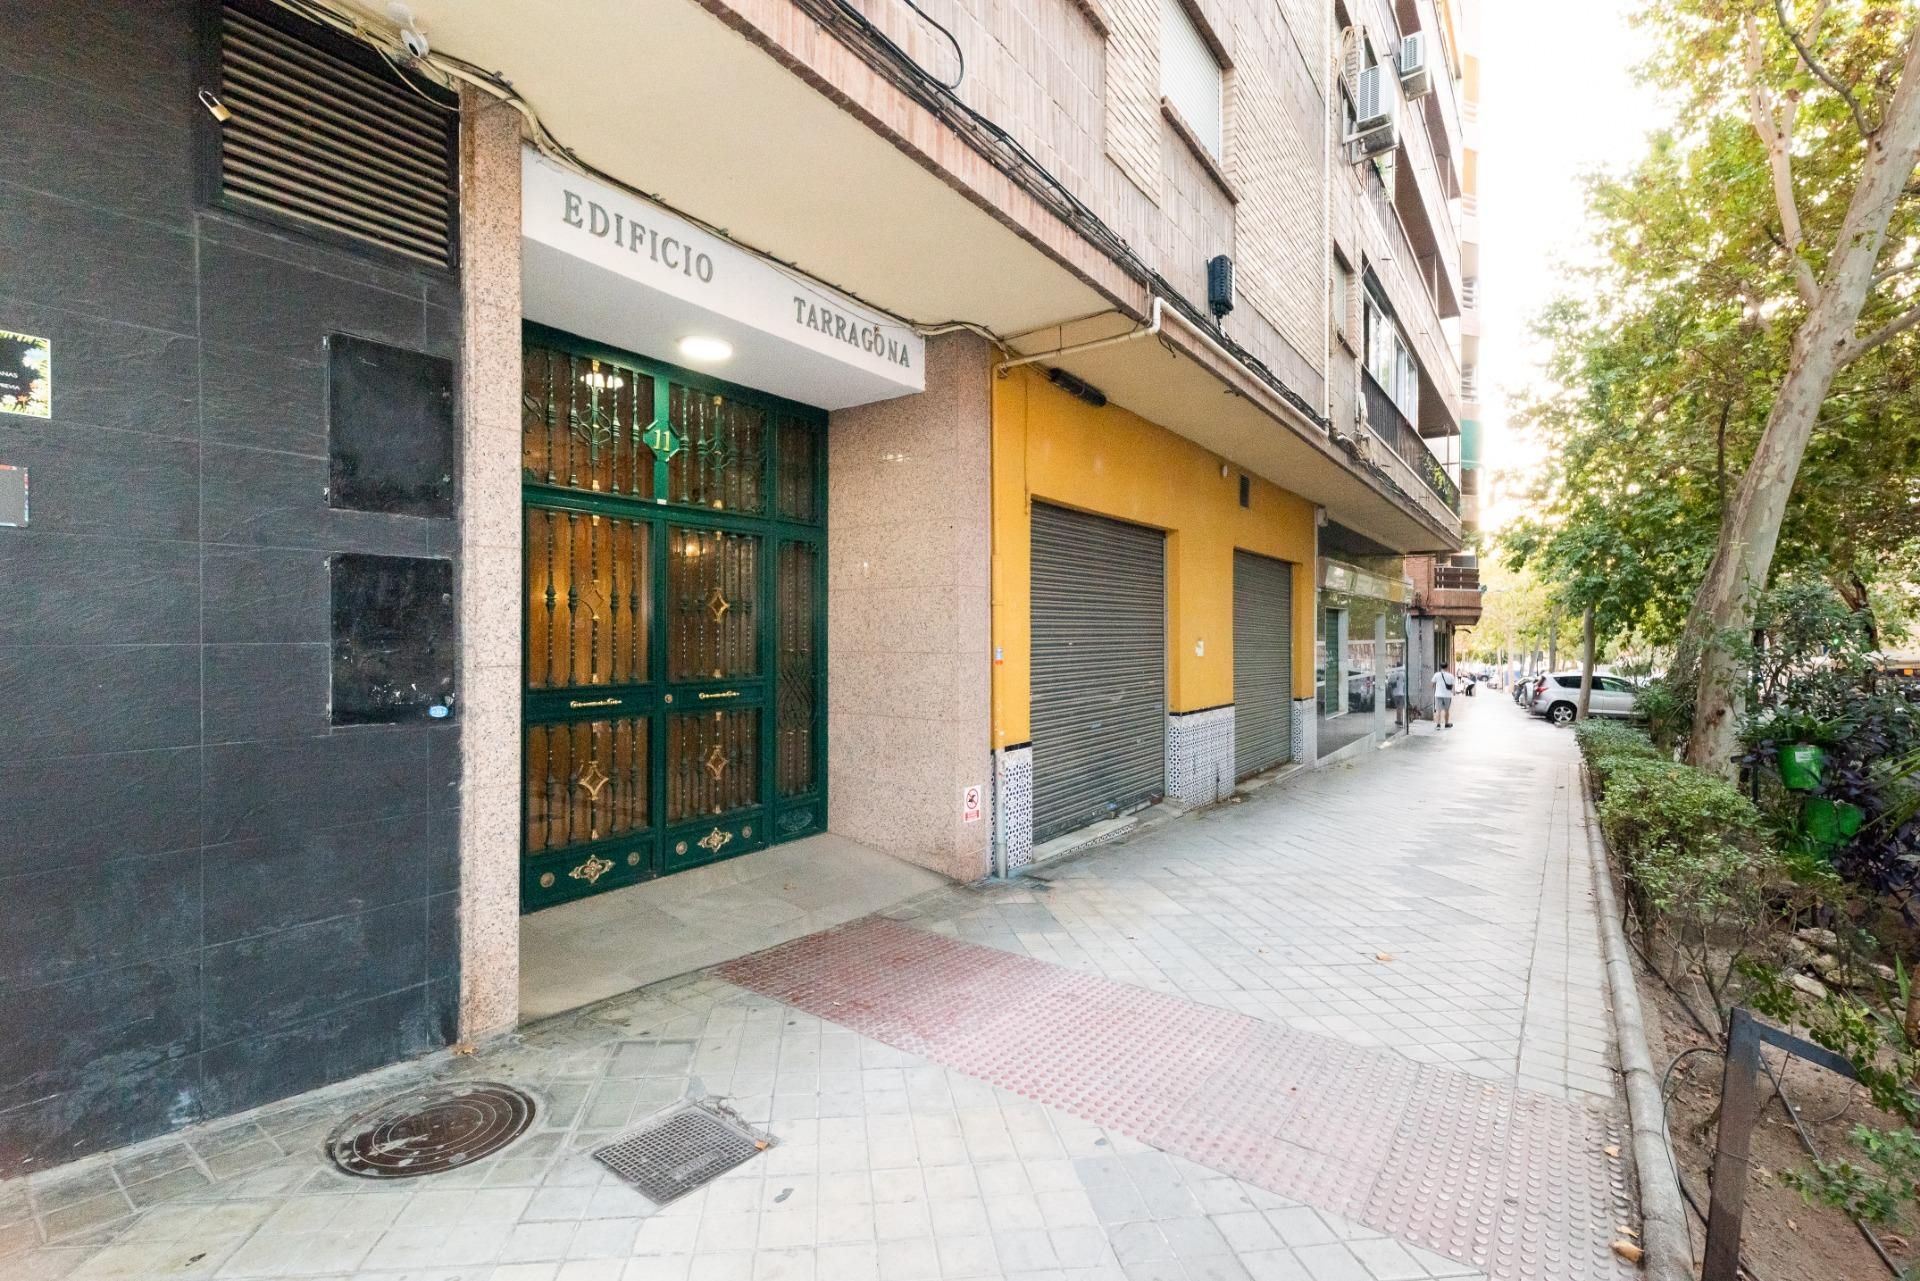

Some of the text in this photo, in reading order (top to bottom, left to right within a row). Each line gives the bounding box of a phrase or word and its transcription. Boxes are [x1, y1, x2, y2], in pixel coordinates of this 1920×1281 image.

[563, 189, 911, 368] EDIFICIO TARRAGONA
[653, 429, 670, 452] 11
